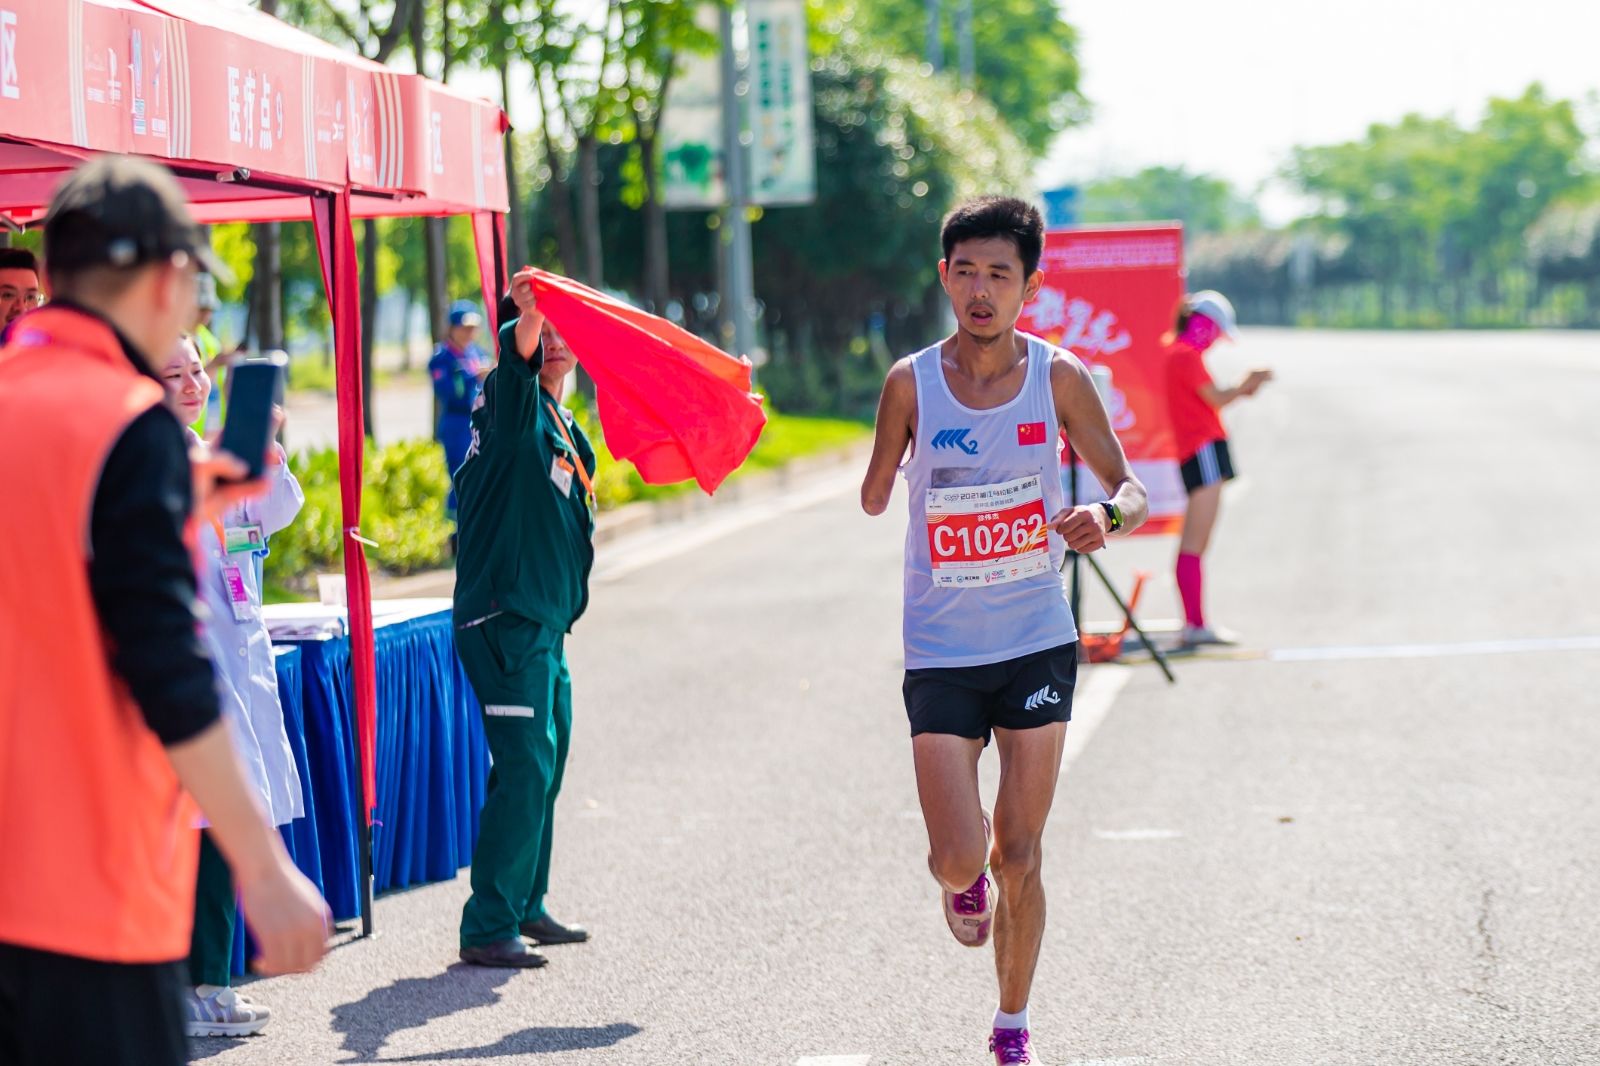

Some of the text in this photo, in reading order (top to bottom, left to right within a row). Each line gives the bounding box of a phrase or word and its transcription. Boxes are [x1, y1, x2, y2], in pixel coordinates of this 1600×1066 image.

[228, 66, 273, 150] 医疗点
[933, 513, 1046, 557] C10262
